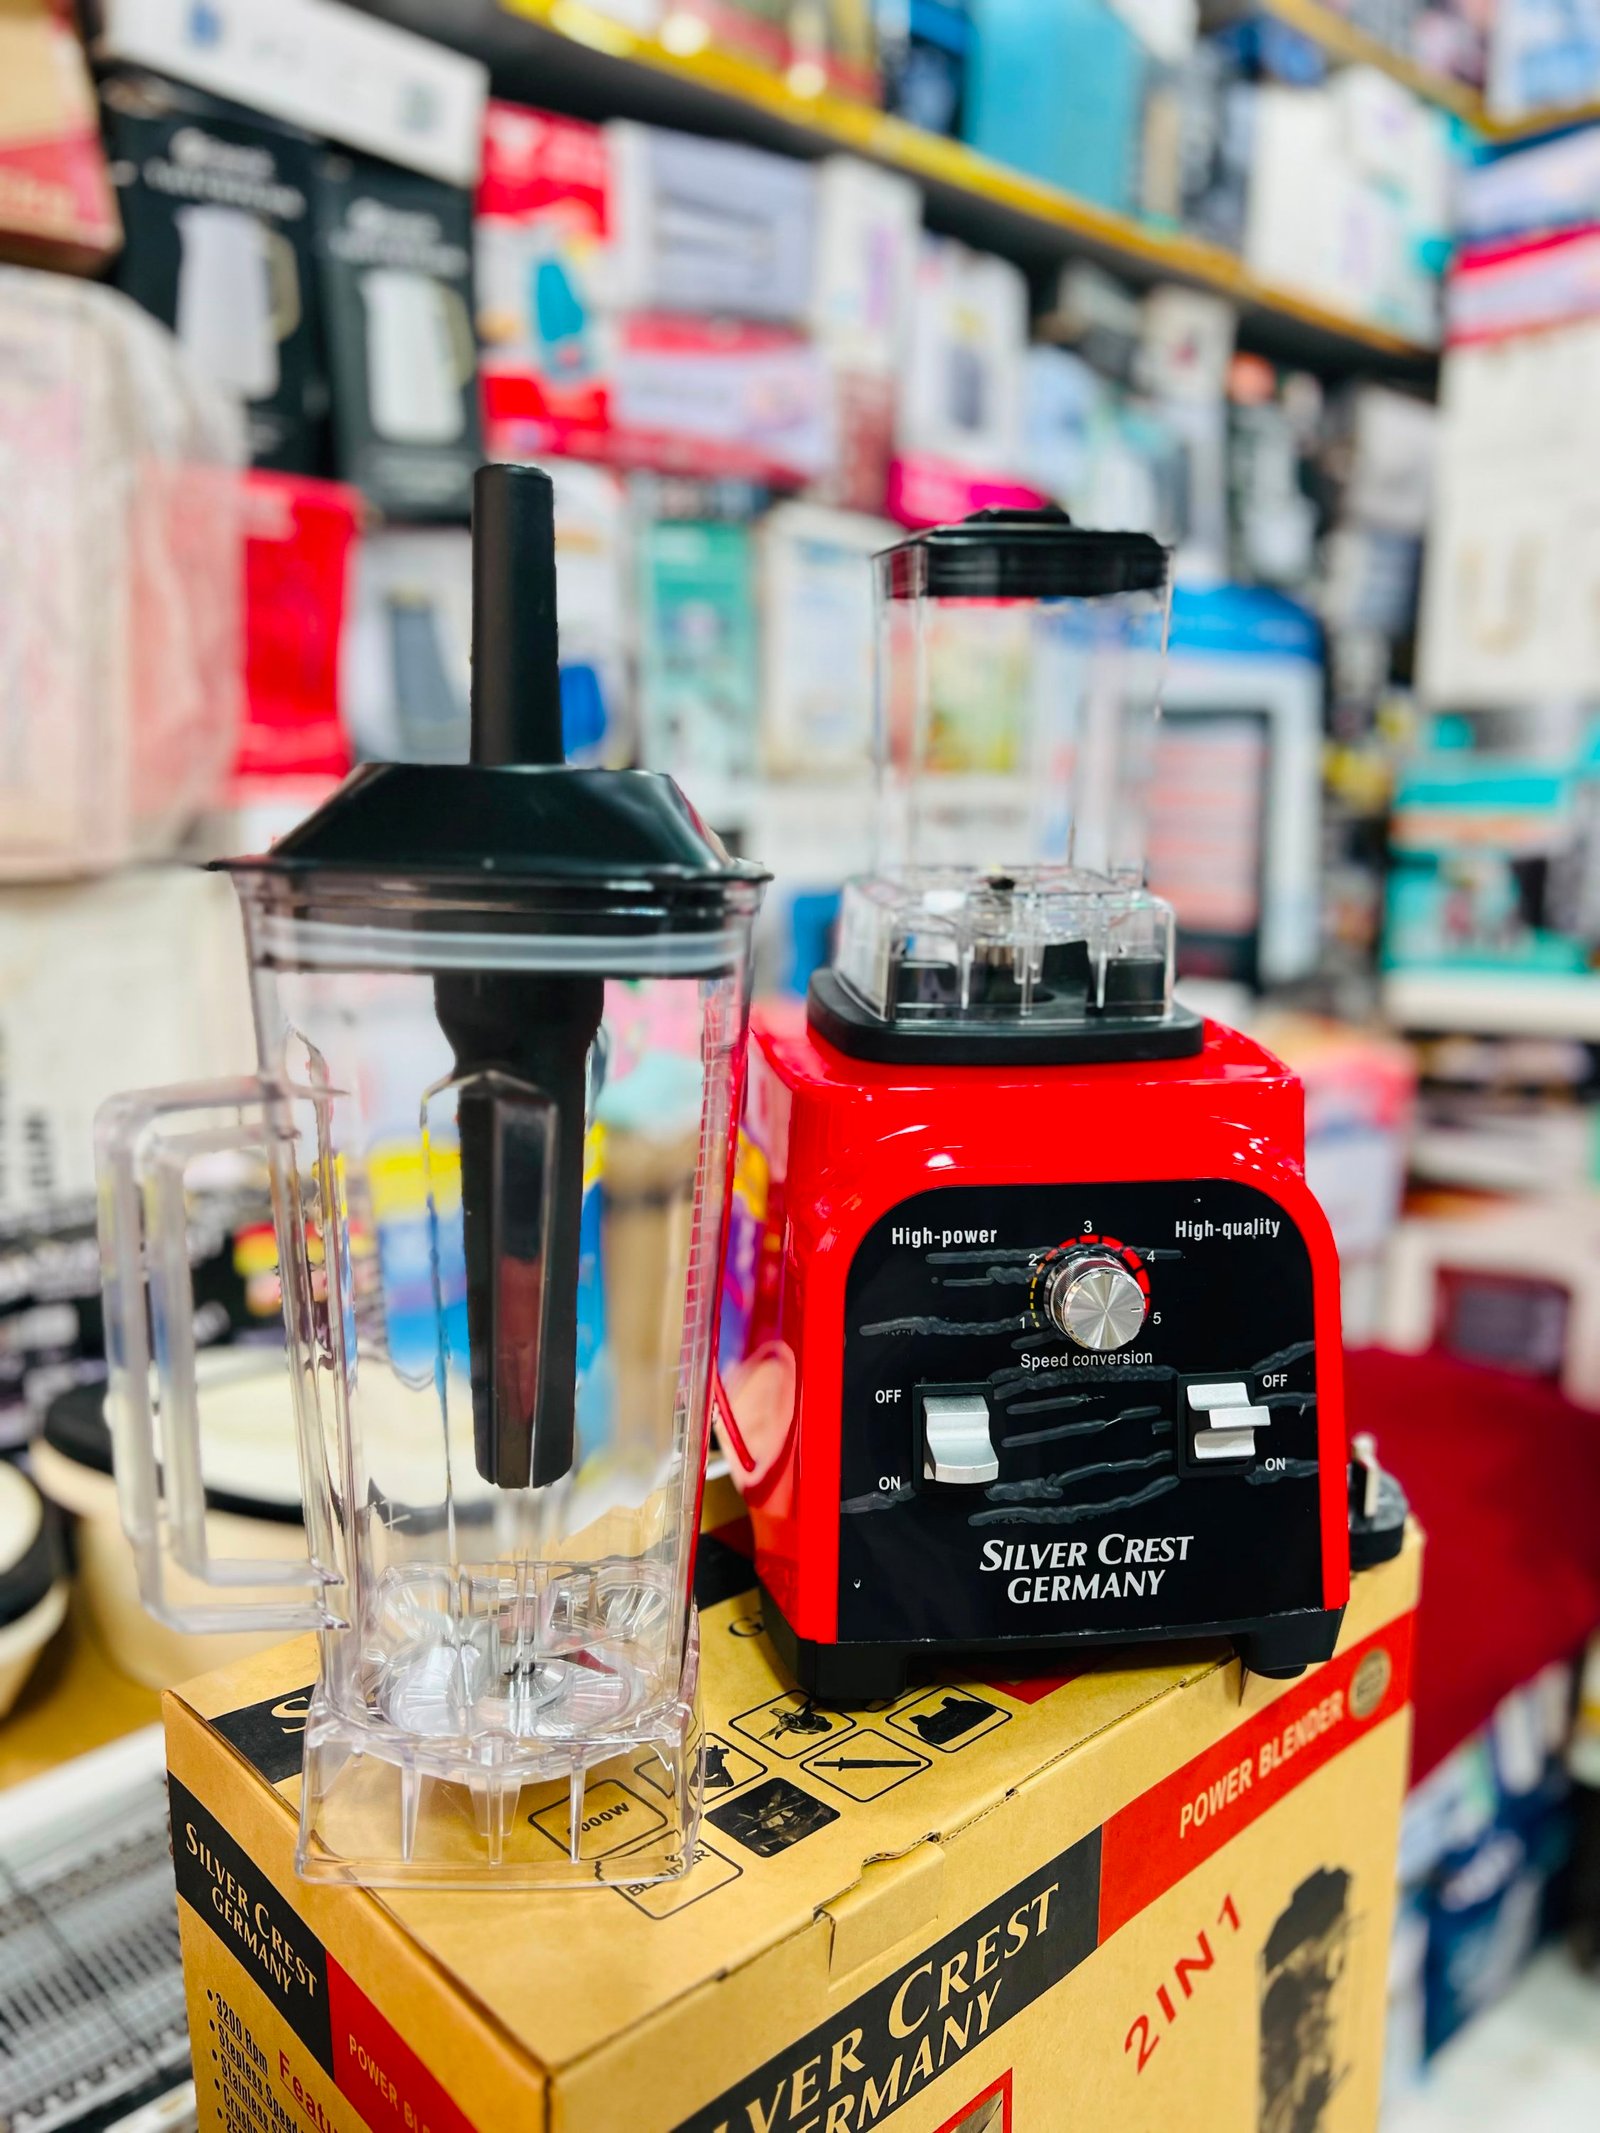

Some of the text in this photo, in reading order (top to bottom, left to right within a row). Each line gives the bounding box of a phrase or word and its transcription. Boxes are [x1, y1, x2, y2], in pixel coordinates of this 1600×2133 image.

[891, 1226, 998, 1248] High-power
[1083, 1220, 1094, 1234] 3
[1174, 1217, 1281, 1240] High-quality
[1027, 1253, 1038, 1268] 2
[1146, 1249, 1157, 1263] 4
[1018, 1316, 1027, 1330] 1
[1152, 1312, 1163, 1326] 5
[1020, 1350, 1153, 1371] Speed conversion
[1262, 1373, 1288, 1388] OFF
[875, 1389, 902, 1404] OFF
[1264, 1457, 1287, 1472] ON
[878, 1475, 902, 1491] ON
[1006, 1569, 1166, 1604] GERMANY
[1179, 1689, 1344, 1840] POWER BLENDER
[211, 1885, 292, 1995] GERMANY
[215, 1992, 268, 2076] 3200 Rpm
[217, 2022, 264, 2097] Stepless
[349, 2033, 399, 2112] POWER
[220, 2053, 270, 2132] Stainless
